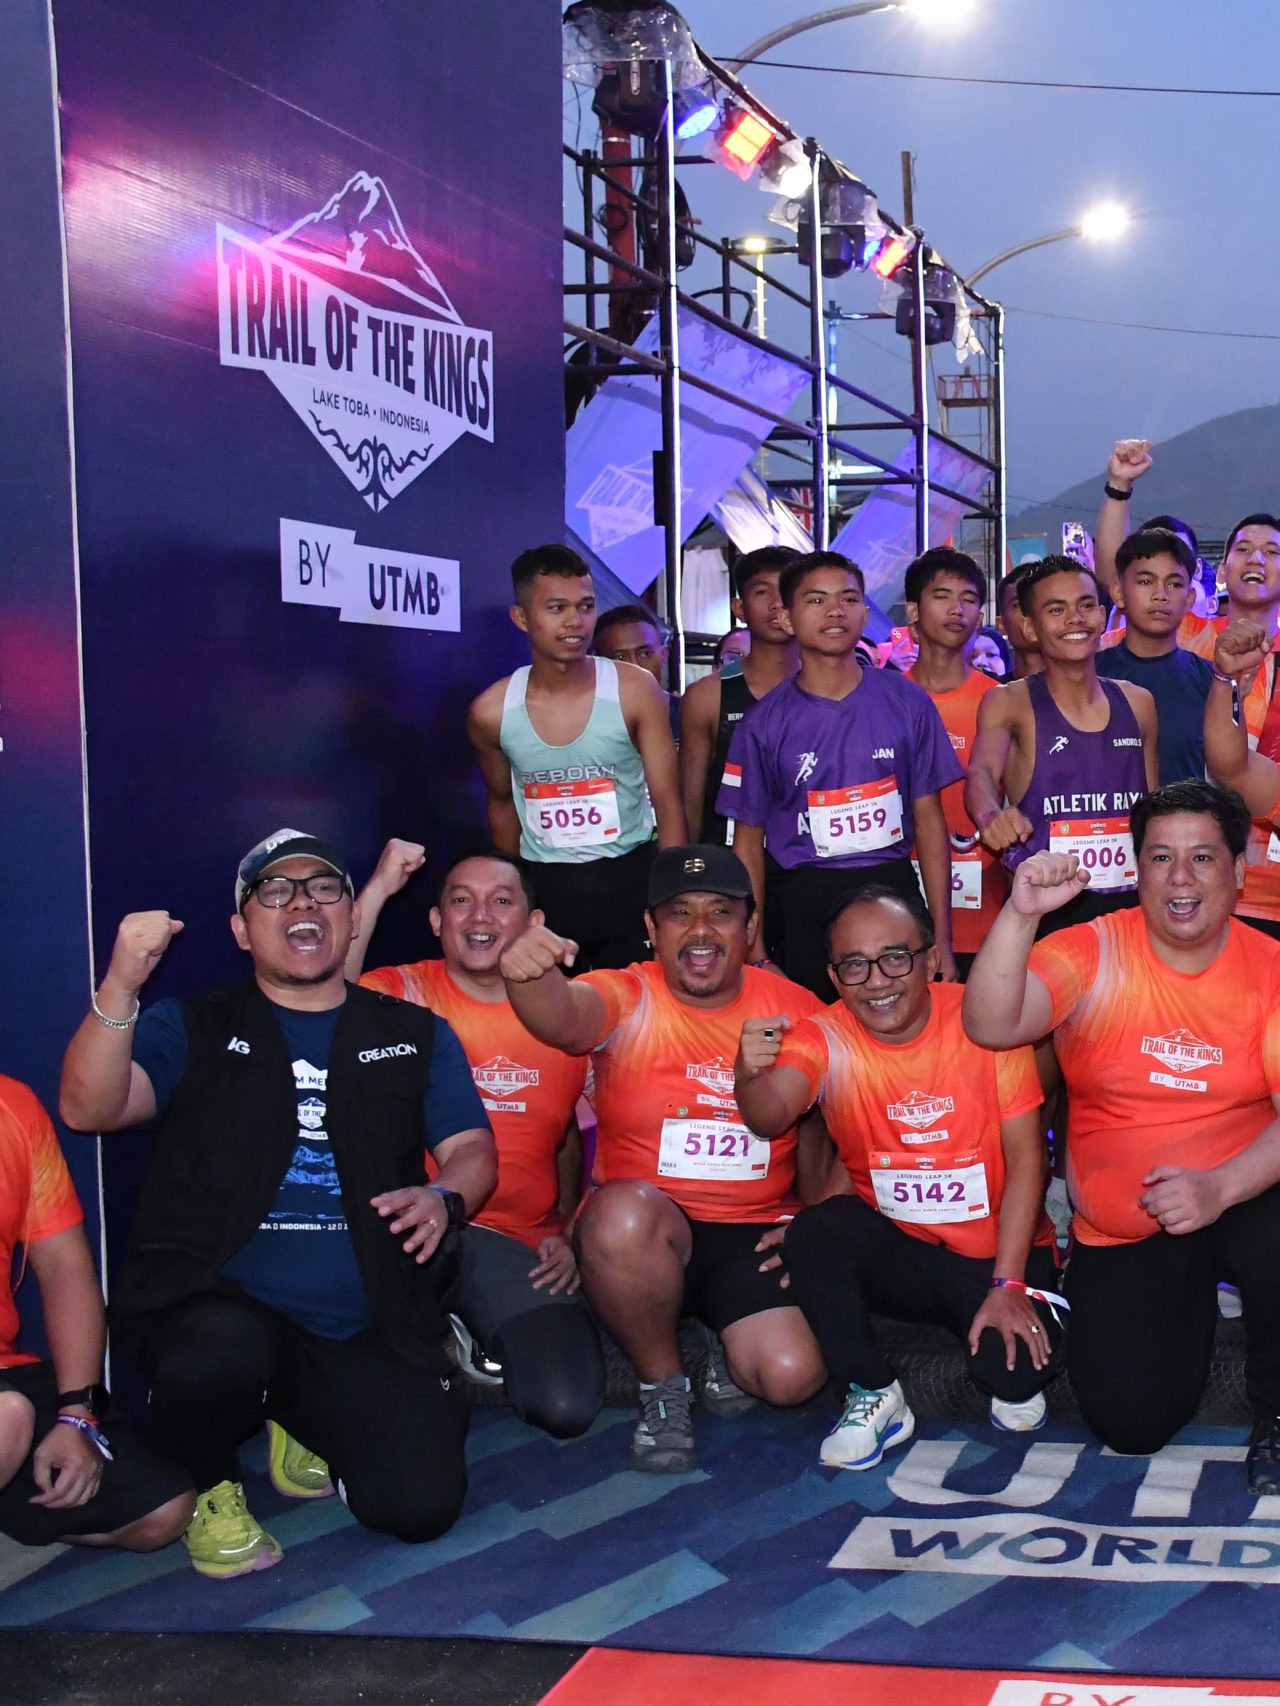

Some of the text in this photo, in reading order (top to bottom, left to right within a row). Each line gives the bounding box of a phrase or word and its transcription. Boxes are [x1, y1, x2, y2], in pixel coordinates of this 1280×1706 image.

[223, 246, 490, 431] TRAIL OF THE KINGS
[312, 387, 430, 434] LAKE TOBA INDONESIA
[298, 538, 441, 616] BY UTMB
[872, 748, 895, 759] JAN
[522, 764, 616, 784] REBORN
[1043, 791, 1143, 815] ATLETIK RAY
[540, 806, 602, 829] 5056
[797, 811, 811, 836] A
[829, 807, 887, 837] 5159
[358, 1043, 418, 1063] CREATION
[1143, 1038, 1166, 1054] TRAIL
[1168, 1044, 1178, 1055] OF
[1180, 1047, 1195, 1058] THE
[1197, 1048, 1221, 1062] KINGS
[487, 1073, 496, 1081] OF
[499, 1073, 513, 1082] THE
[515, 1072, 538, 1084] KINGS
[687, 1065, 735, 1082] TRAIL OF THE
[1174, 1079, 1199, 1089] UTMB
[888, 1098, 953, 1119] TRAIL OF THE KINGS
[689, 1123, 717, 1131] LEGEND
[921, 1133, 943, 1141] UTMB
[684, 1132, 749, 1157] 5121
[893, 1181, 966, 1203] 5142
